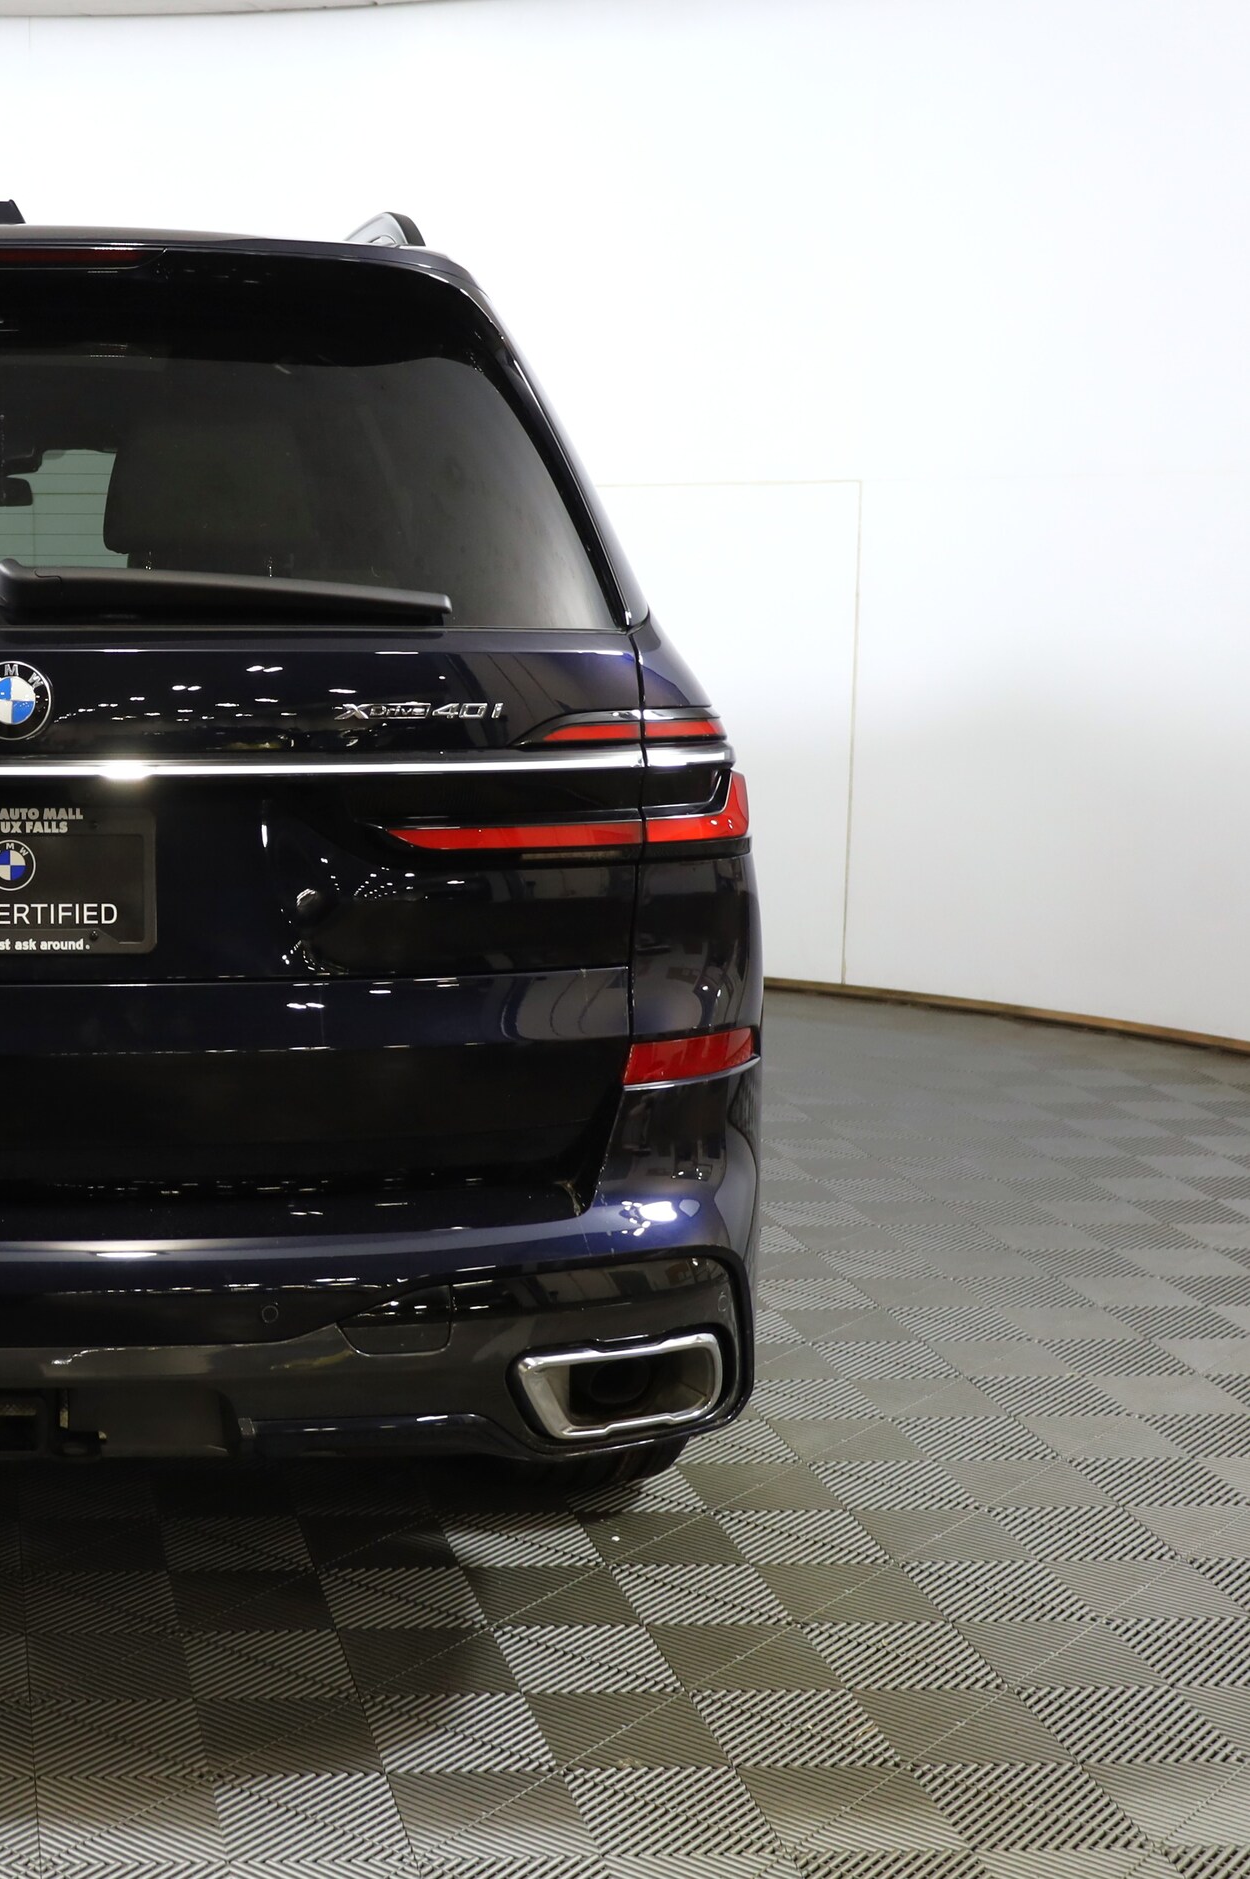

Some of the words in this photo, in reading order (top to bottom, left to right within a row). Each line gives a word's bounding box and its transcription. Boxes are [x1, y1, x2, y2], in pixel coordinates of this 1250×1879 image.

[42, 807, 84, 820] MALL
[25, 821, 69, 834] FALLS
[14, 938, 37, 951] ask
